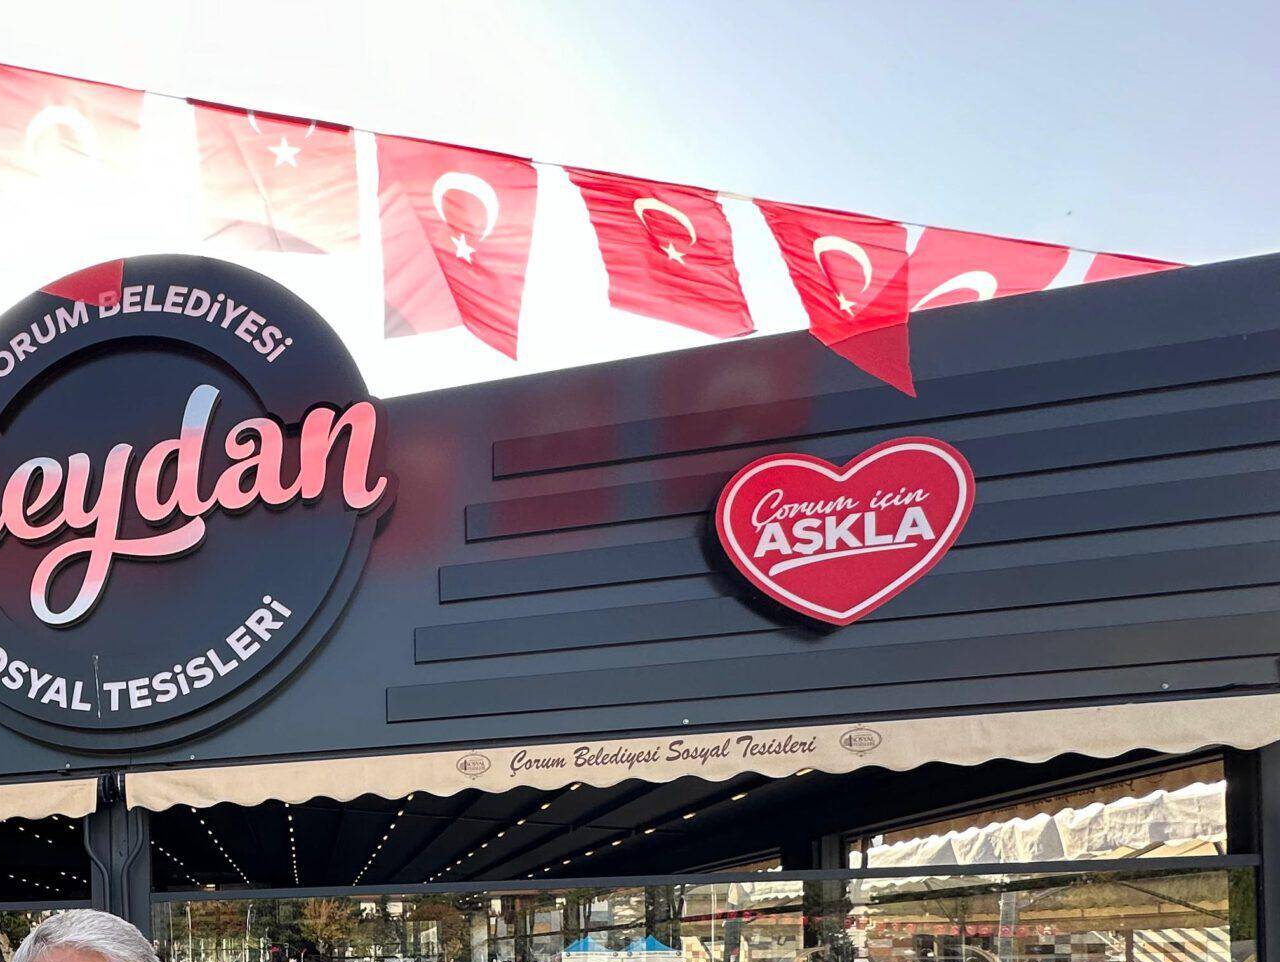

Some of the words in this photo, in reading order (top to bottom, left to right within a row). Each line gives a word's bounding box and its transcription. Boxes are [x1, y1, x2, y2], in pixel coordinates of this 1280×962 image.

[869, 486, 930, 511] için
[509, 750, 567, 778] Çorum
[573, 745, 660, 774] Belediyesi
[666, 738, 731, 769] Sosyal
[734, 734, 817, 758] Tesisleri
